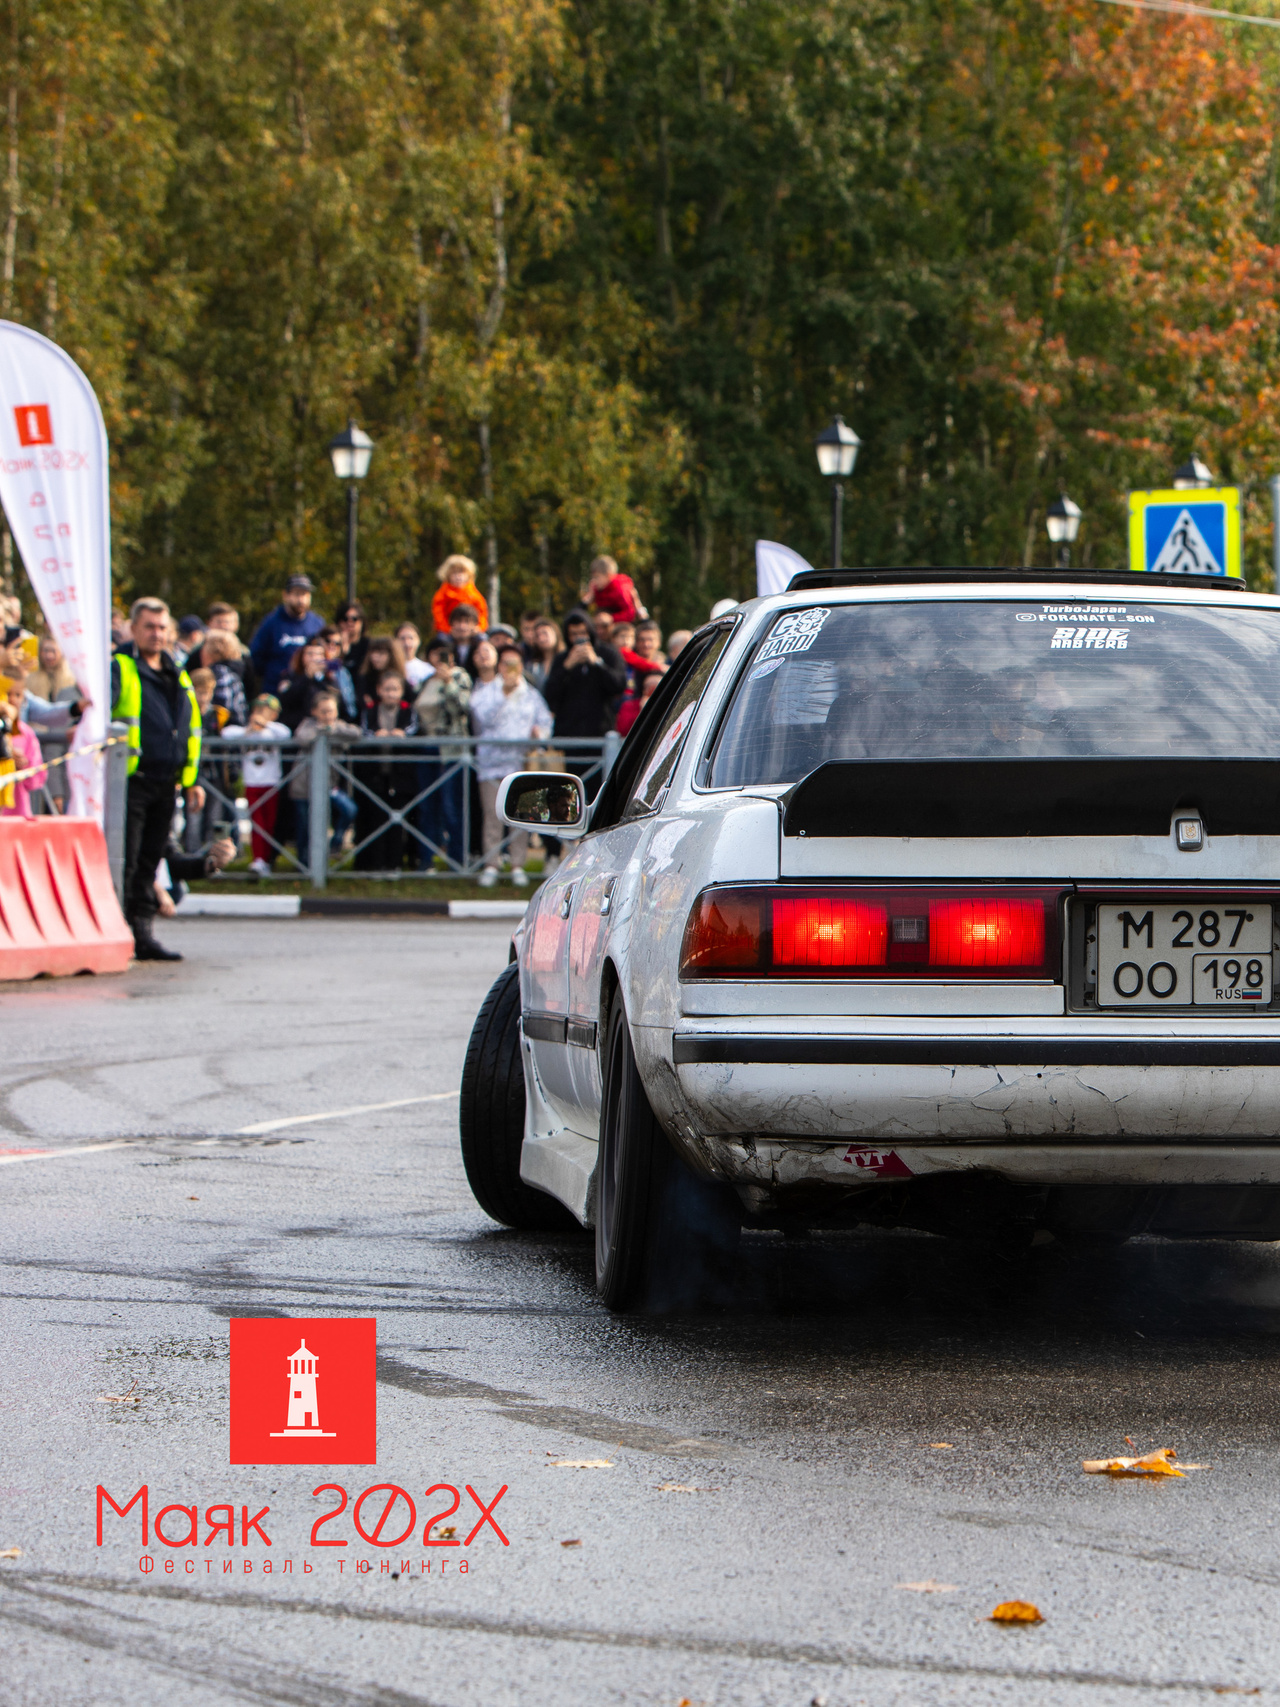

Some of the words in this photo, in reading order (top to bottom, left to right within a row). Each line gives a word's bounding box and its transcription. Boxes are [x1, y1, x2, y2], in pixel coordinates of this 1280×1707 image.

[1042, 605, 1127, 614] TurboJapan
[1052, 627, 1131, 640] SIDE
[756, 633, 818, 662] HARD!
[1171, 910, 1247, 948] 287
[1202, 959, 1263, 989] 198
[1215, 989, 1242, 1000] RUS
